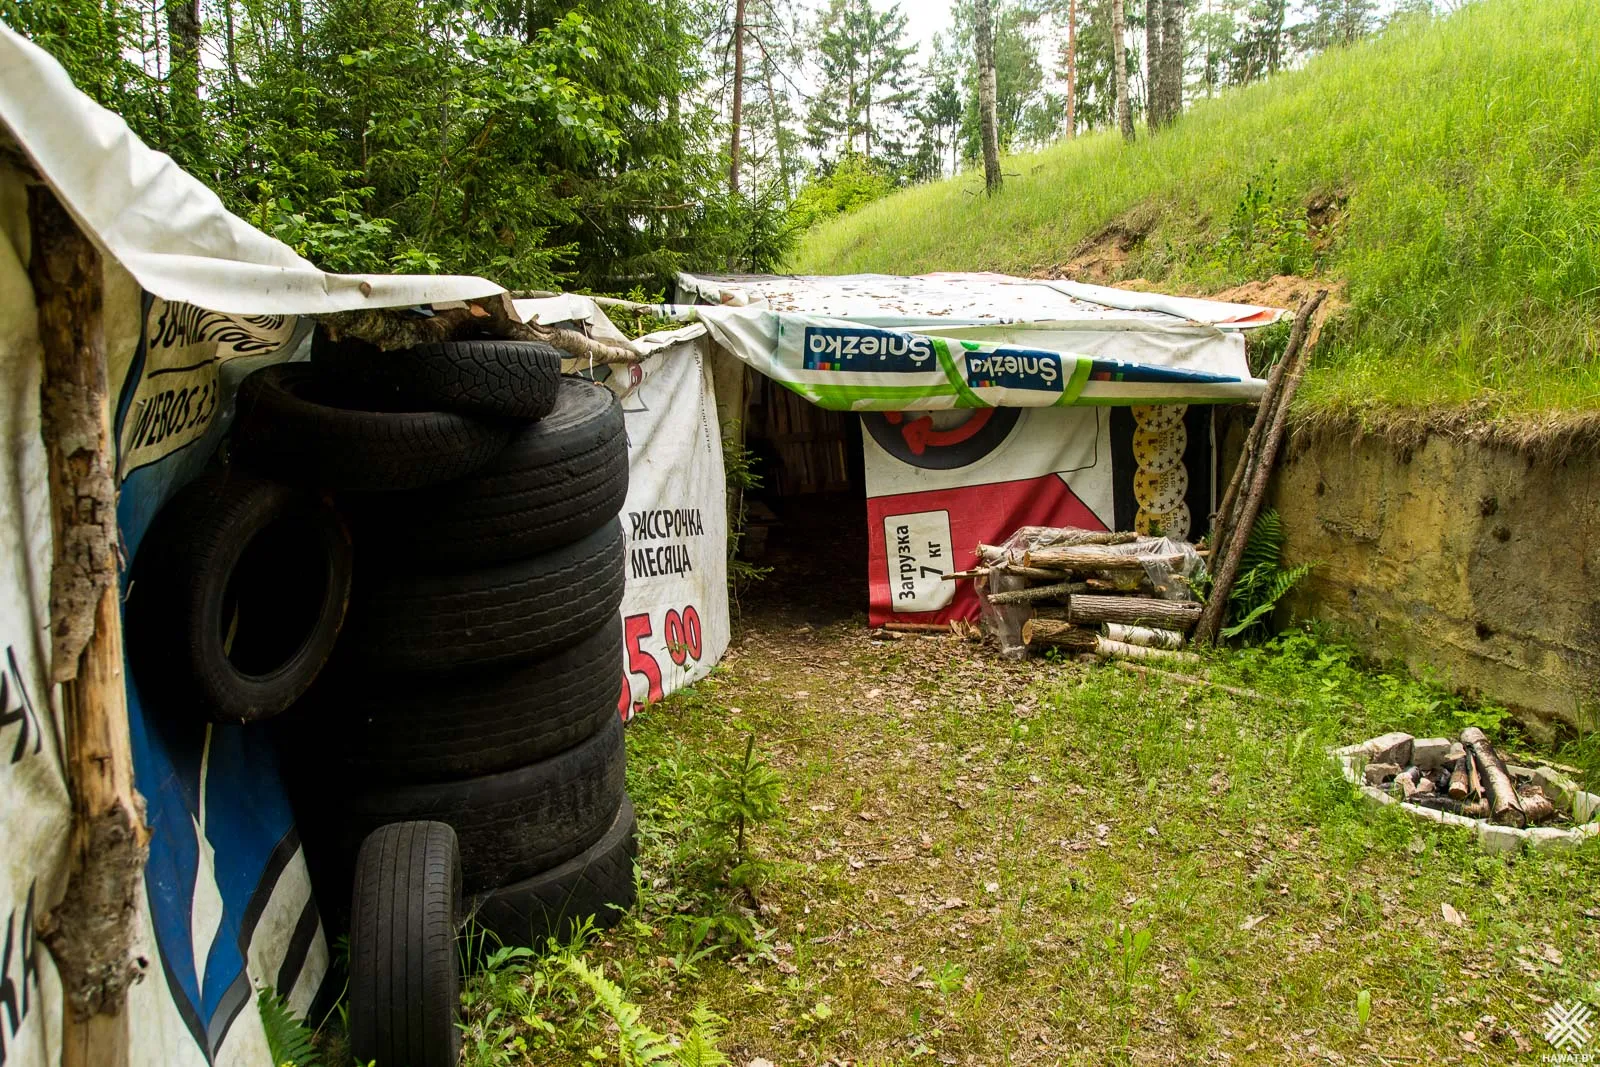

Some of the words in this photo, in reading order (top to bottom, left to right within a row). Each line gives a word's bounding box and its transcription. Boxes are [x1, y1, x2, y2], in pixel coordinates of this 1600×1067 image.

[809, 334, 931, 367] Śnieżka
[971, 353, 1058, 386] Śnieżka
[130, 385, 200, 450] WEBOS
[628, 508, 704, 541] РАССРОЧКА
[631, 544, 692, 579] МЕСЯЦА
[896, 525, 917, 600] Загрузка
[928, 541, 942, 558] кг
[919, 565, 944, 579] 7
